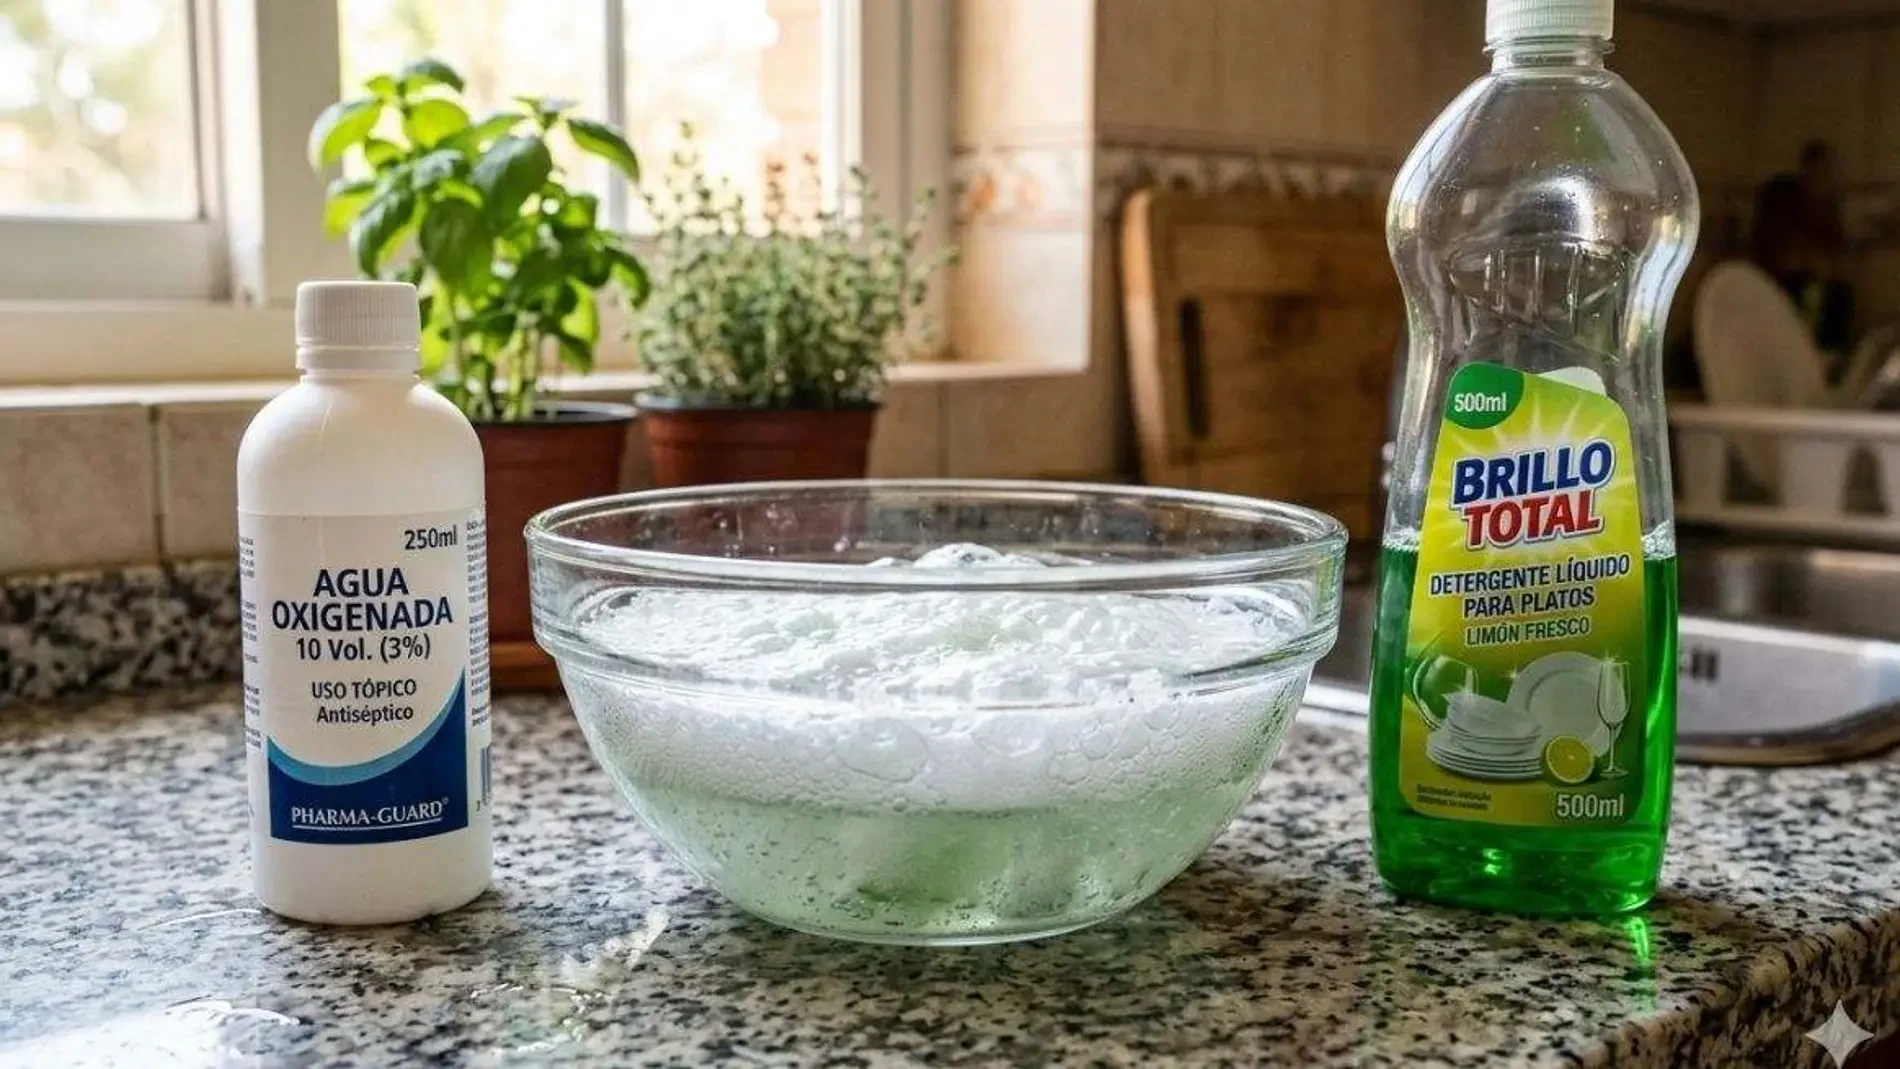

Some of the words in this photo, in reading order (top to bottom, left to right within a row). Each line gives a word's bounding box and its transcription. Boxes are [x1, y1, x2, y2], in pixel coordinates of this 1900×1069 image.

[1454, 391, 1507, 413] 500ml
[1453, 441, 1613, 506] BRILLO
[1464, 489, 1602, 546] TOTAL
[403, 526, 458, 550] 250ml
[313, 568, 409, 597] AGUA
[1430, 565, 1550, 596] DETERGENTE
[1555, 554, 1630, 582] LÍQUIDO
[272, 597, 453, 631] OXIGENADA
[1463, 594, 1516, 619] PARA
[1520, 585, 1595, 615] PLATOS
[1466, 624, 1520, 646] LIMÓN
[1525, 617, 1590, 640] FRESCO
[297, 638, 322, 660] 10
[328, 638, 373, 661] Vol.
[380, 634, 431, 662] (3%)
[311, 681, 348, 699] USO
[352, 678, 417, 698] TÓPICO
[316, 705, 414, 727] Antiséptico
[1556, 794, 1625, 819] 500ml
